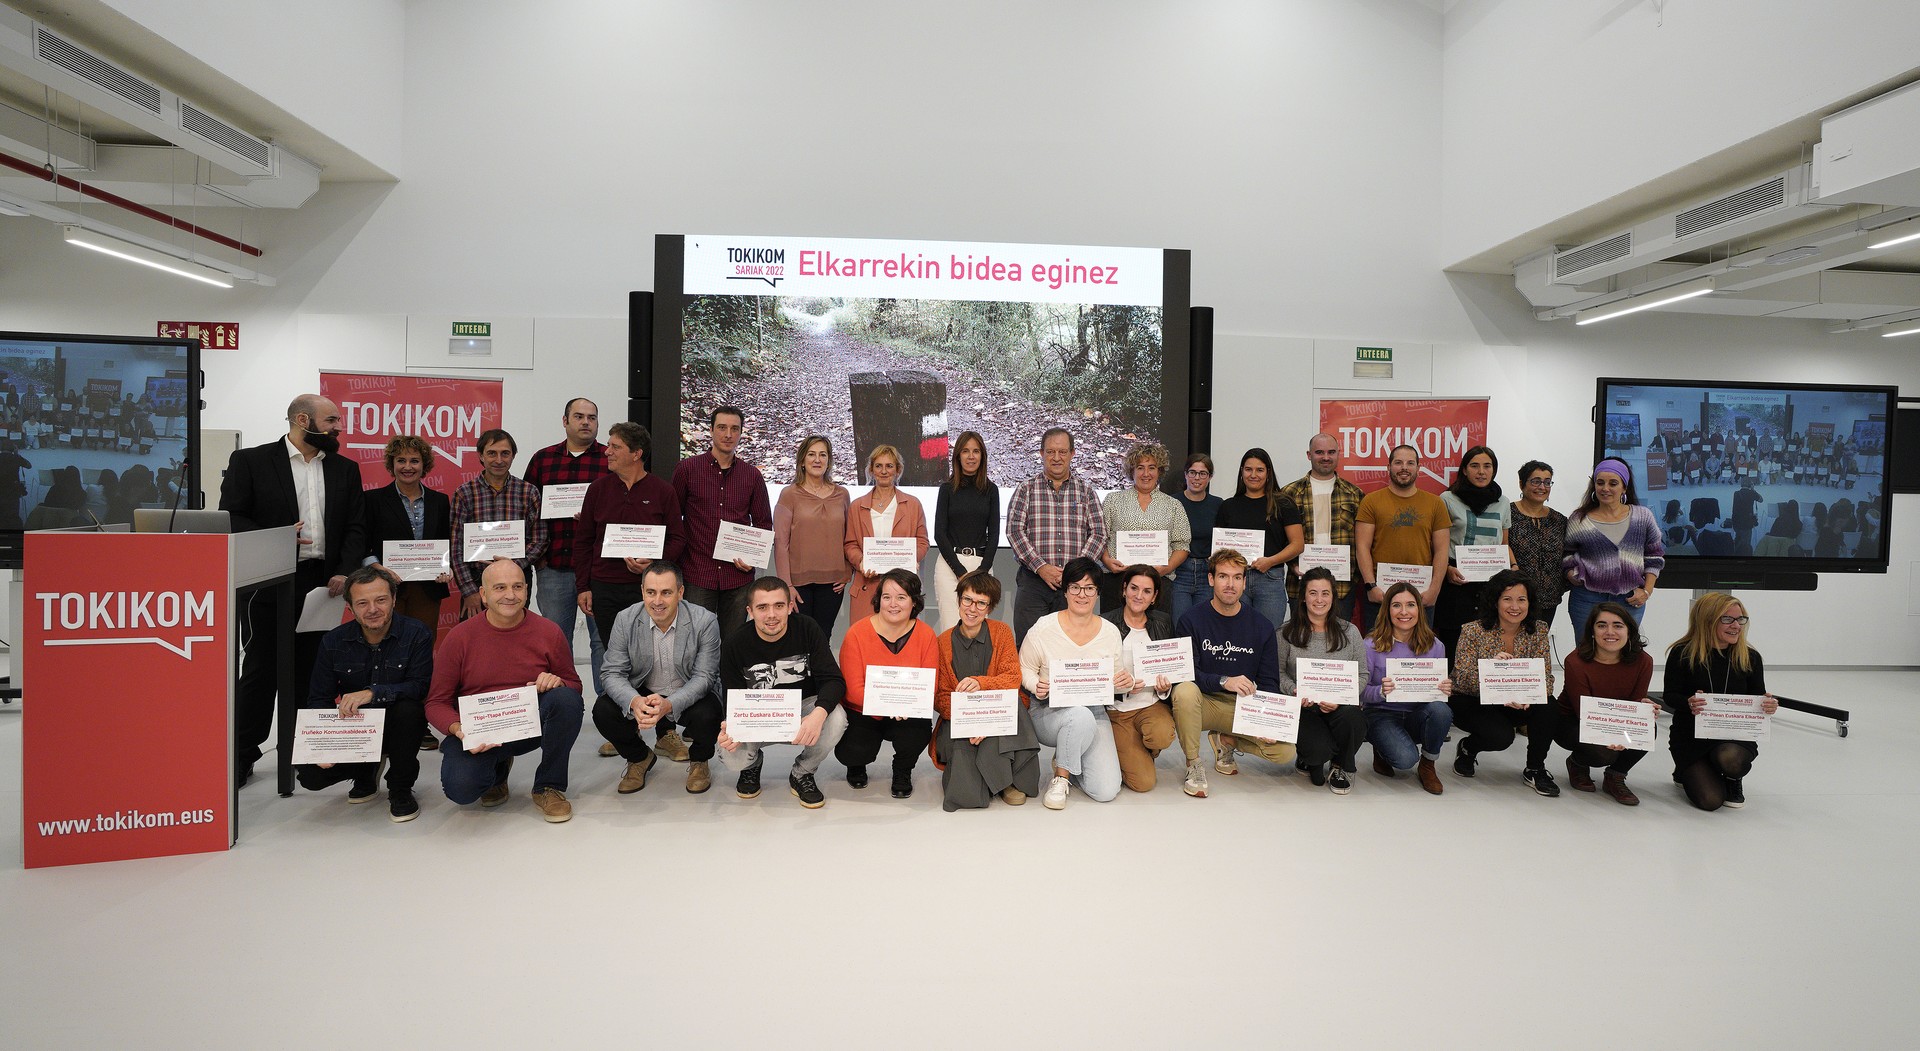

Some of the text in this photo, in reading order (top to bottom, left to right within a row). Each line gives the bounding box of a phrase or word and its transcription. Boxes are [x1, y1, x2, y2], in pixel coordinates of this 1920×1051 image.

[727, 247, 785, 264] TOKIKOM
[735, 265, 784, 276] SARIAK 2022
[800, 250, 1118, 290] Elkarrekin bidea eginez
[455, 324, 488, 334] IRTEERA
[1360, 350, 1390, 359] IRTEERA
[90, 382, 118, 392] TOKIKOM
[348, 376, 396, 391] TOKIKOM
[1344, 402, 1387, 416] TOKIKOM
[342, 402, 482, 438] TOKIKOM
[1339, 427, 1468, 459] TOKIKOM
[36, 590, 214, 630] TOKIKOM
[1202, 638, 1254, 656] Pepe Jeans
[38, 808, 214, 837] www.tokikom.eus
